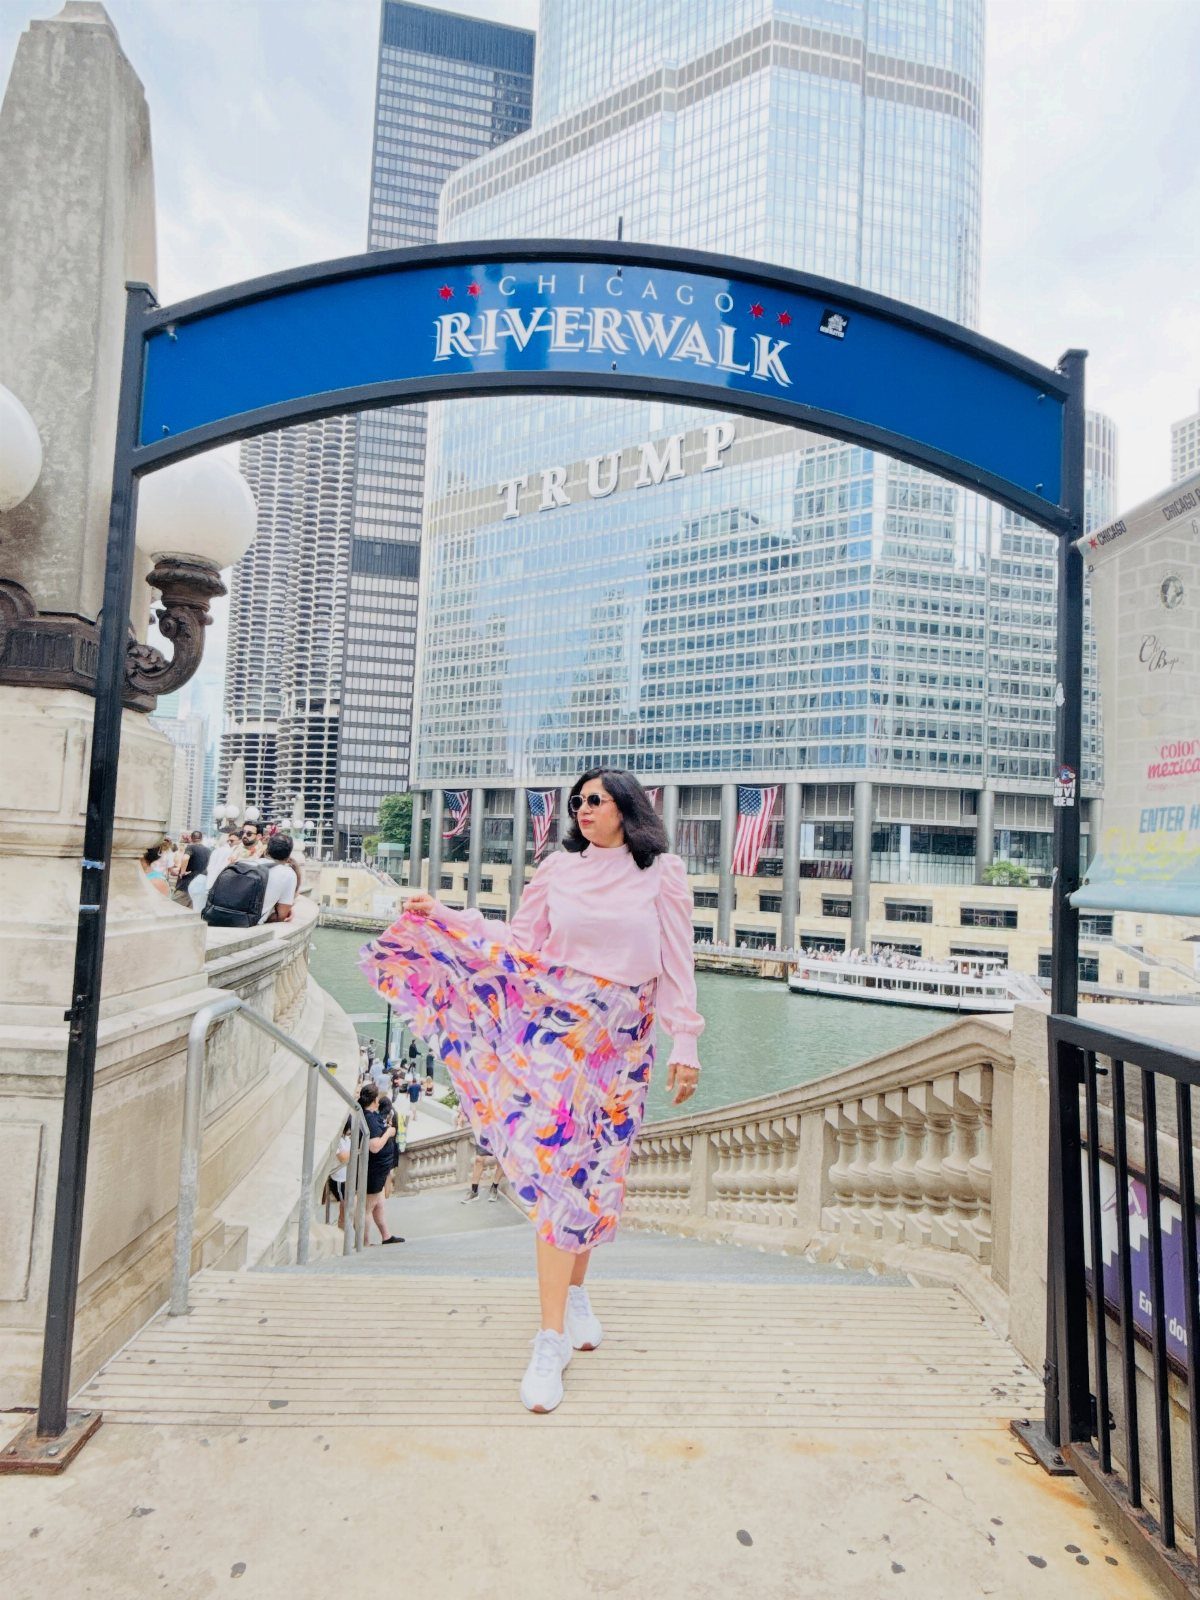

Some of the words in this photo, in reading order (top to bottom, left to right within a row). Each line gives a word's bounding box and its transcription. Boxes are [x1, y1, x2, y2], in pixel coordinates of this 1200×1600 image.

[498, 273, 734, 314] CHICAGO
[432, 305, 794, 388] RIVERWALK
[496, 420, 736, 520] TRUMP
[1162, 492, 1197, 521] CHICAGO
[1096, 520, 1127, 546] CHICAGO
[1138, 806, 1185, 833] ENTER
